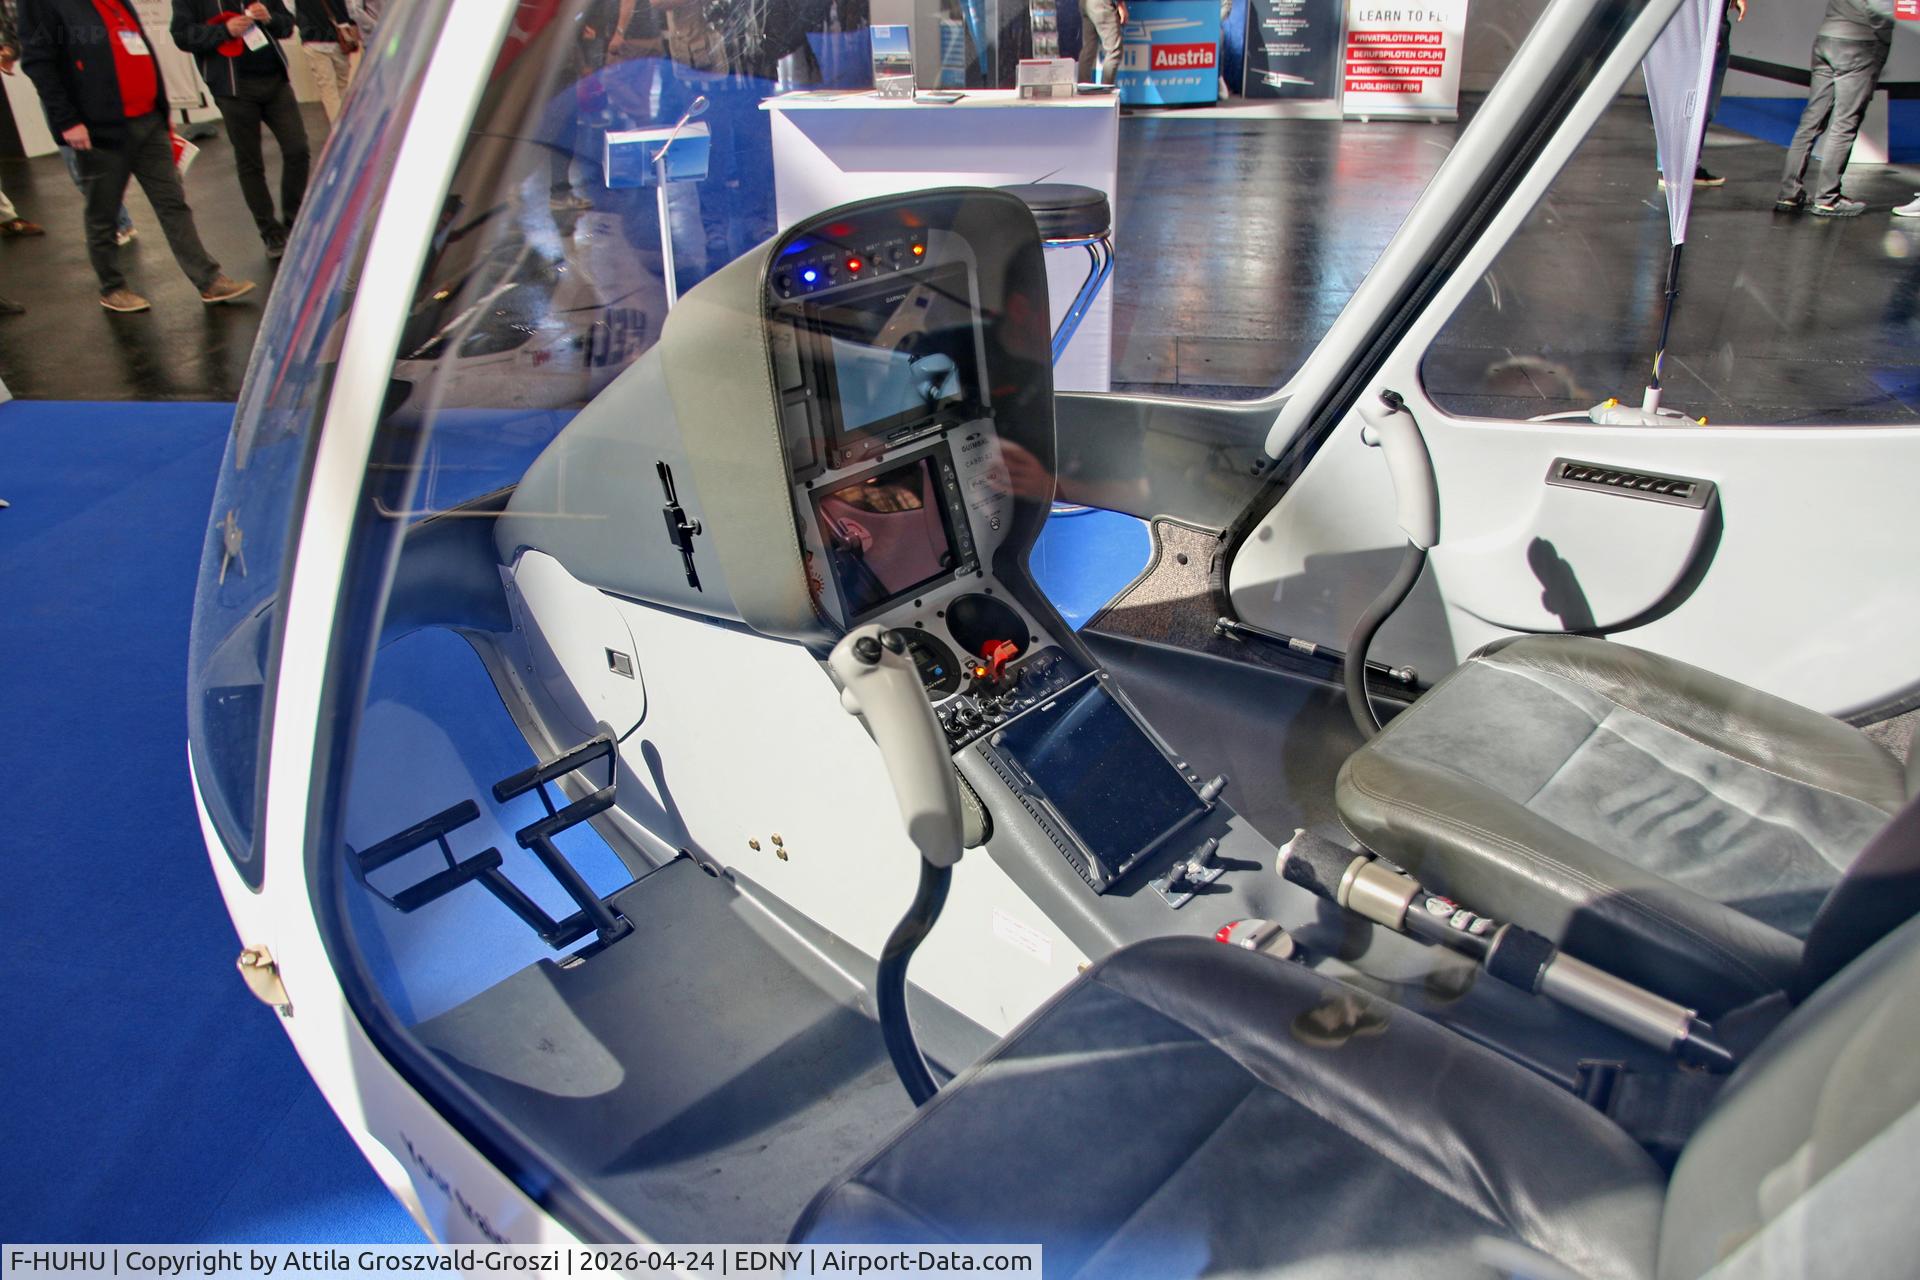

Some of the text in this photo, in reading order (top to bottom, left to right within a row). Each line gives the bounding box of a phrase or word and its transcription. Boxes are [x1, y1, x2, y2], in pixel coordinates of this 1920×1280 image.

[1359, 10, 1448, 22] LEARN TO FL
[1355, 34, 1440, 43] PRIVATPILOTEN PPL(H)
[1155, 48, 1213, 66] Austria
[1417, 51, 1442, 60] CPL(H)
[1352, 66, 1439, 76] LINIENPILOTEN ATPL(H)
[1352, 82, 1402, 91] FLUGLEHRER
